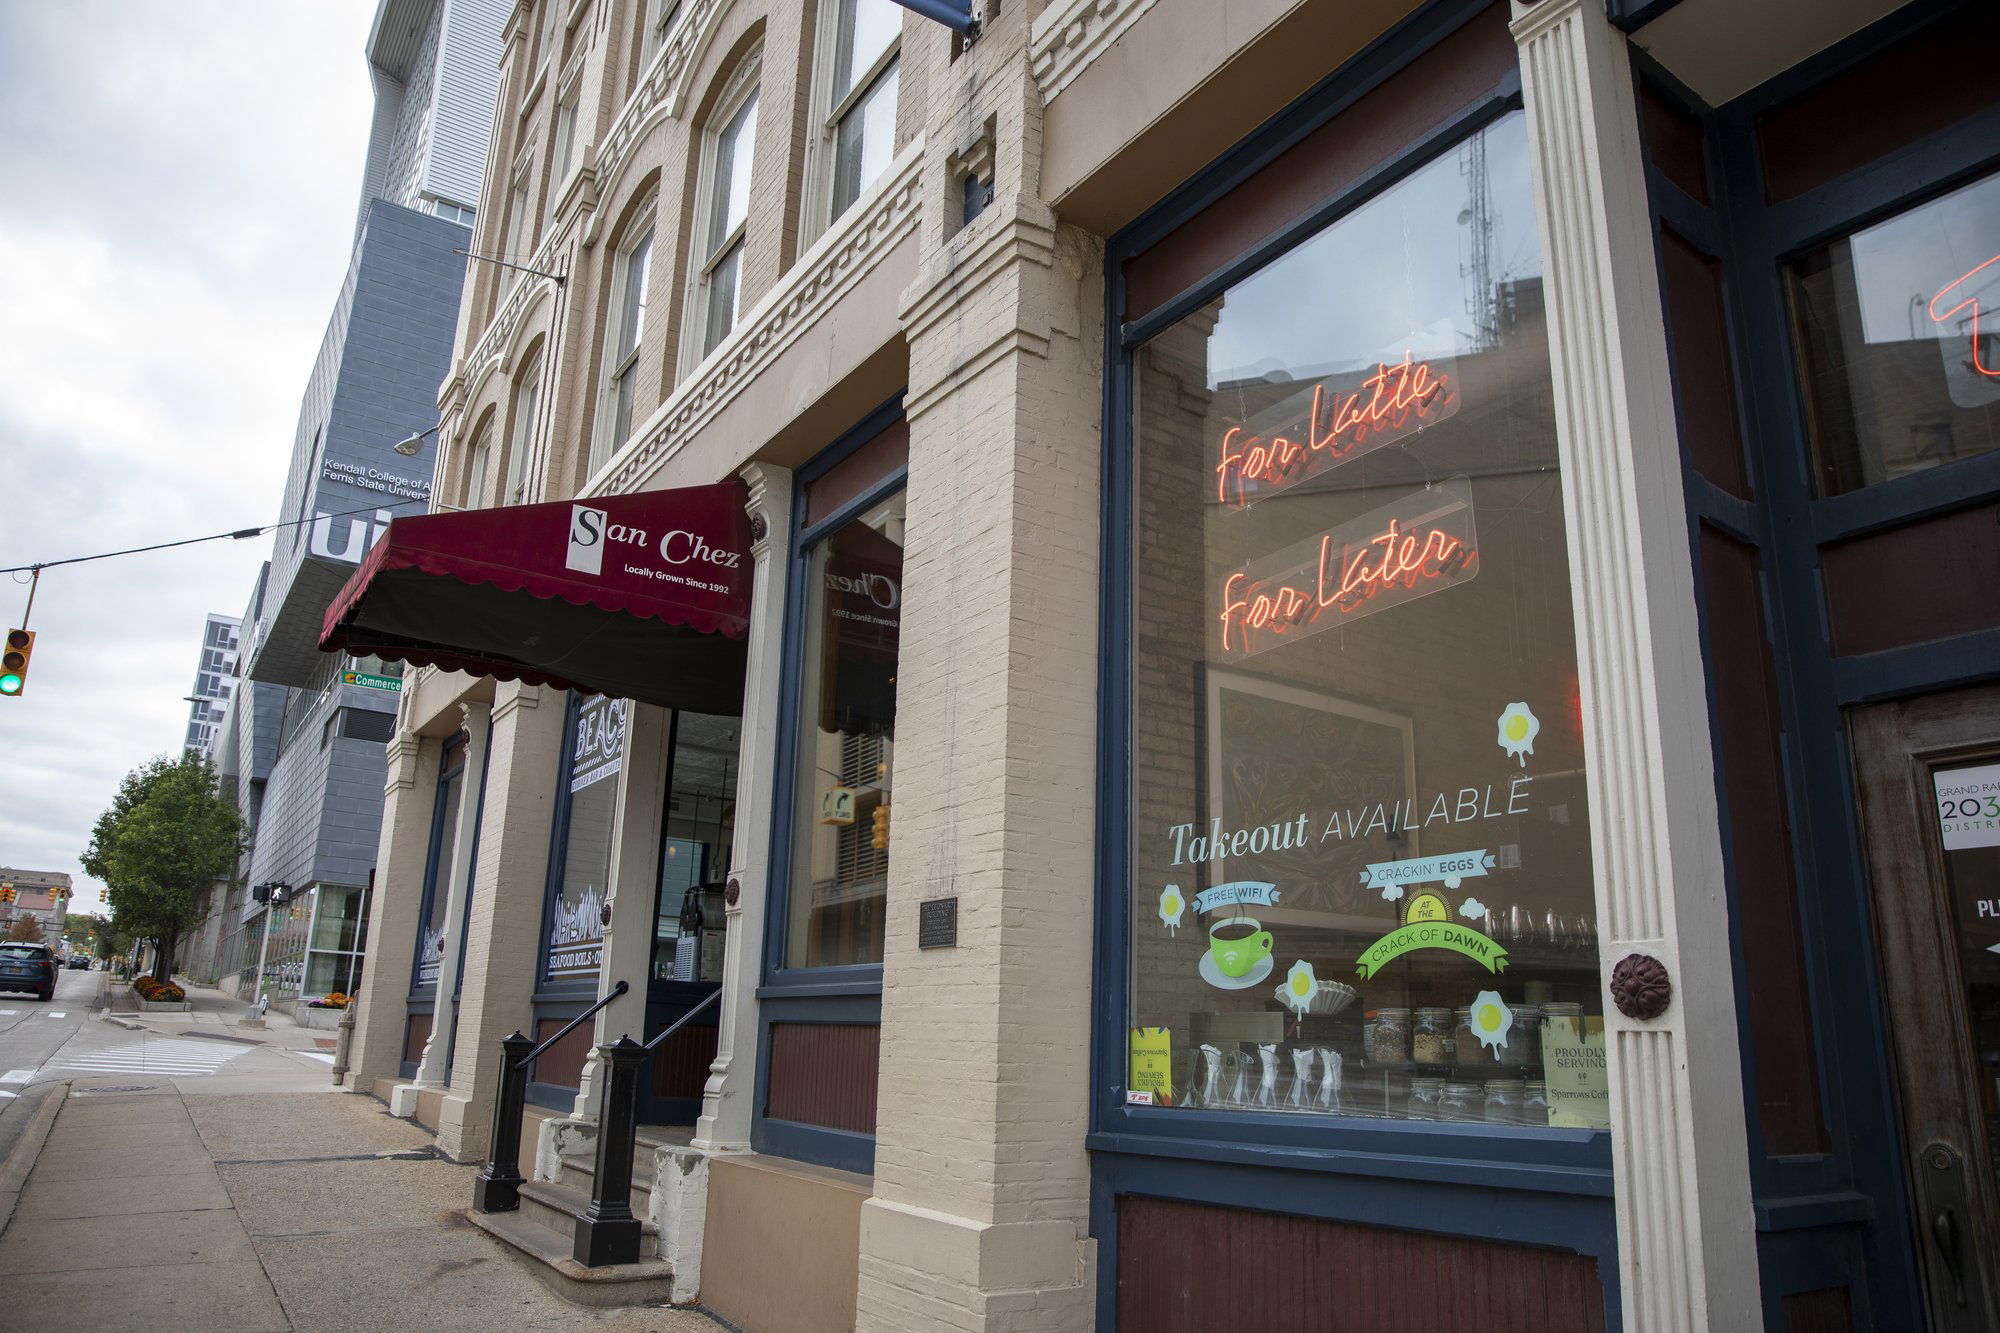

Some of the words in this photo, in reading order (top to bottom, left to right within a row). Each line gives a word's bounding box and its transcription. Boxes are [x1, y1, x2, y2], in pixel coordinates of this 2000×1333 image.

[1217, 427, 1297, 503] for
[1310, 350, 1440, 450] Latte
[322, 469, 354, 484] Ferris
[356, 476, 386, 492] State
[324, 458, 366, 476] Kendall
[368, 468, 408, 486] College
[410, 480, 422, 488] of
[571, 510, 648, 547] San
[659, 530, 741, 569] Chez
[624, 563, 654, 579] Locally
[655, 570, 684, 584] Grown
[685, 577, 707, 590] Since
[709, 582, 729, 595] 1992
[1220, 573, 1303, 651] for
[1319, 519, 1459, 607] Later
[355, 674, 401, 691] Commerce
[1938, 784, 1979, 797] GRAND
[1168, 812, 1310, 867] Takeout
[1320, 776, 1533, 844] AVAILABLE
[1439, 858, 1475, 874] EGGS
[1207, 888, 1234, 904] FREE
[1237, 887, 1262, 898] WIFI
[1420, 900, 1431, 910] AT
[1977, 899, 2000, 918] PL
[1417, 909, 1434, 919] THE
[1372, 931, 1416, 962] CRACK
[1419, 929, 1440, 941] OF
[1443, 930, 1489, 957] DAWN
[549, 953, 575, 969] SEAFOOD
[1554, 1047, 1607, 1058] PROUDLY
[1557, 1058, 1607, 1069] SERVING
[1551, 1088, 1590, 1101] Sparrows
